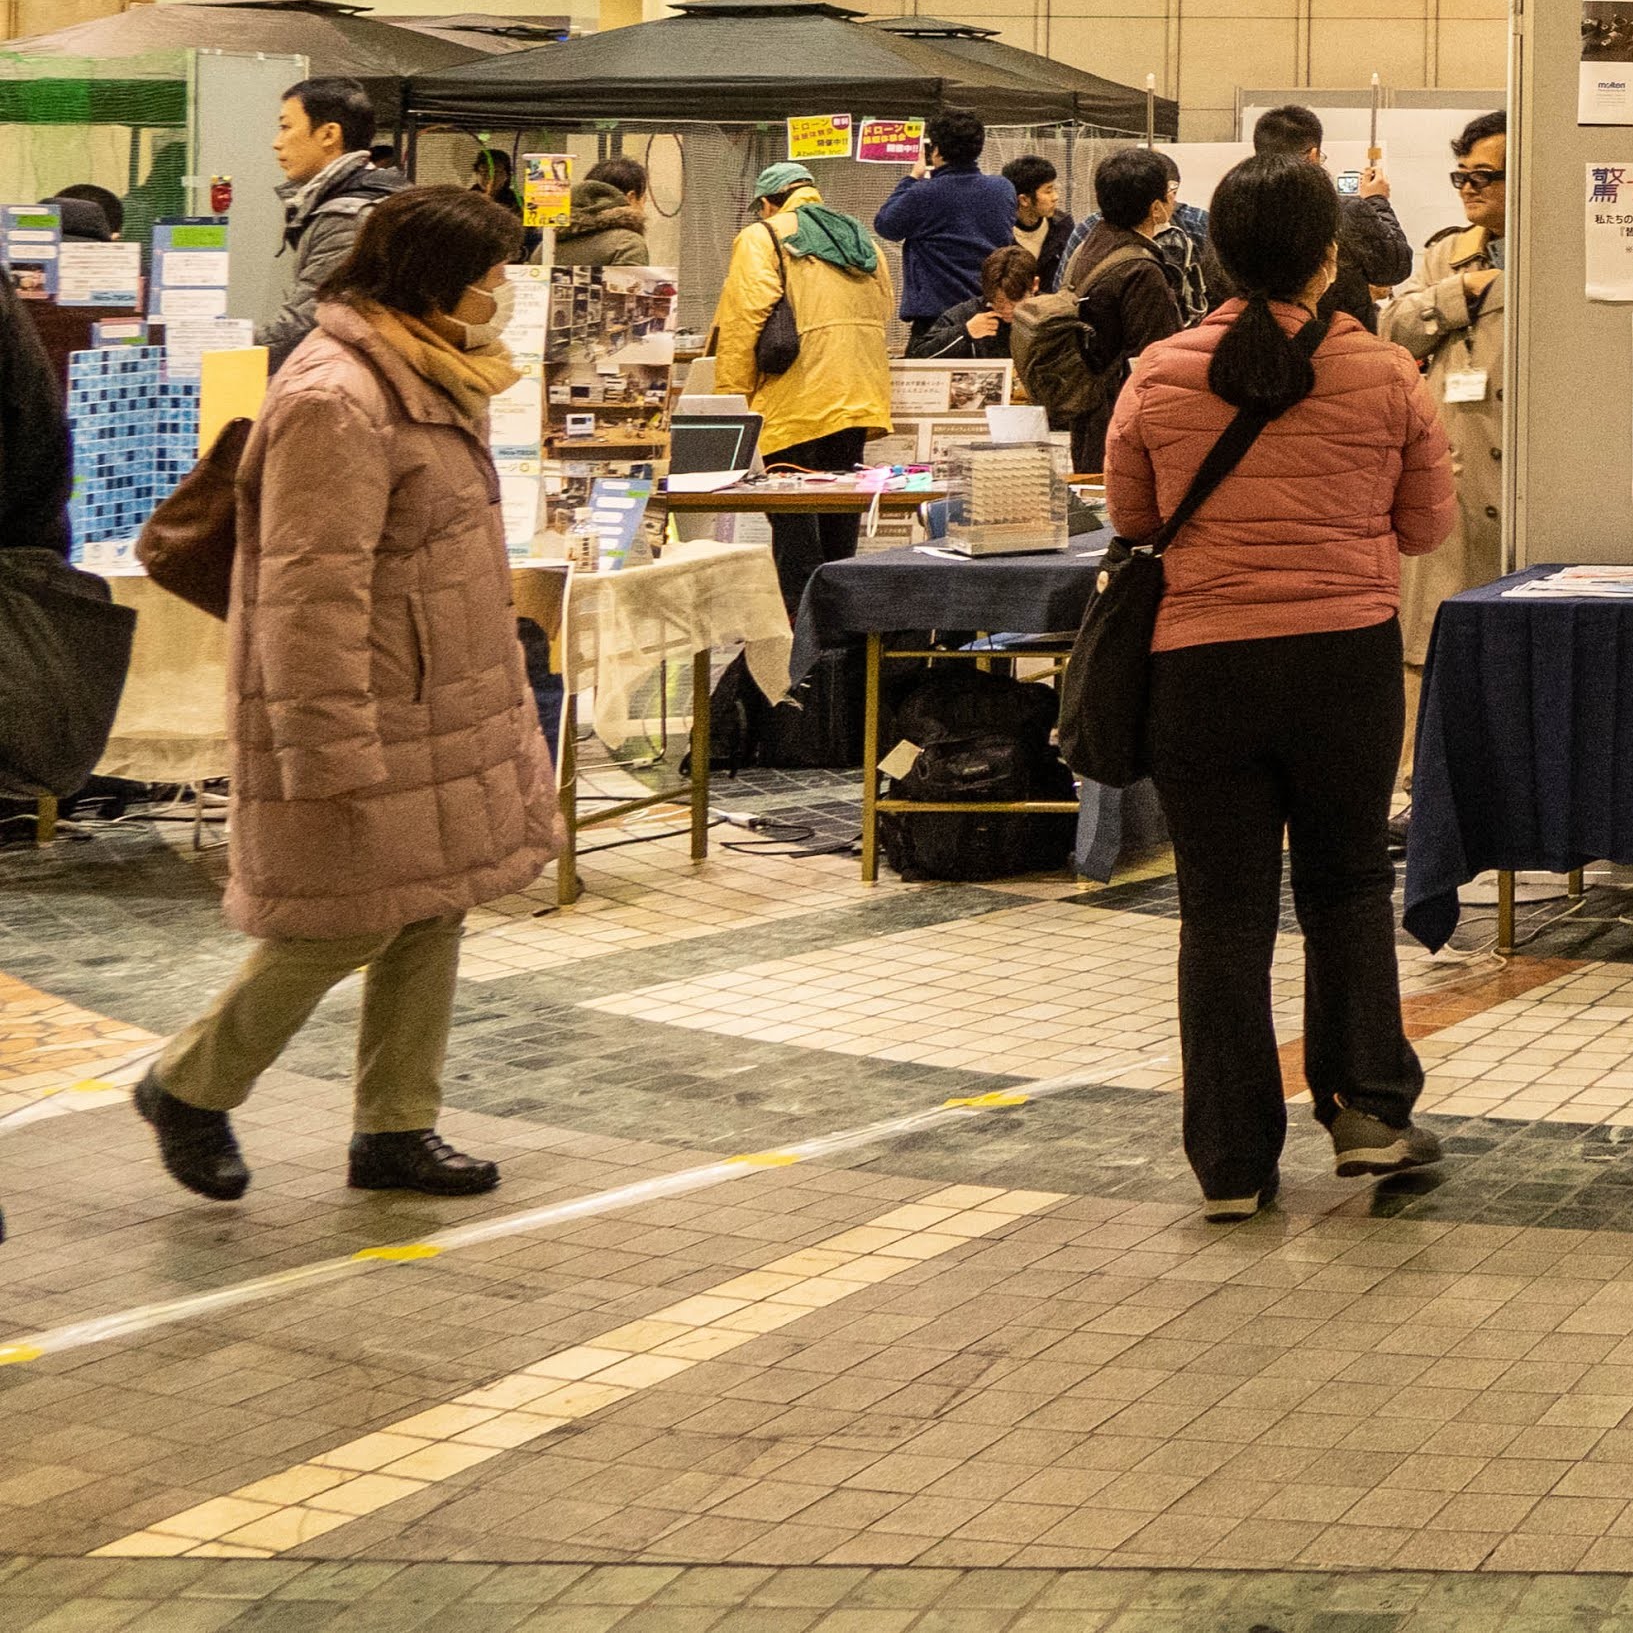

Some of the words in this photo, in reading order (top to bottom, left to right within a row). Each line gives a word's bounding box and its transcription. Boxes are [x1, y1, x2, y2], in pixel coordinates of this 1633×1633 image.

[792, 119, 830, 131] ドローン
[863, 124, 903, 136] ドローン
